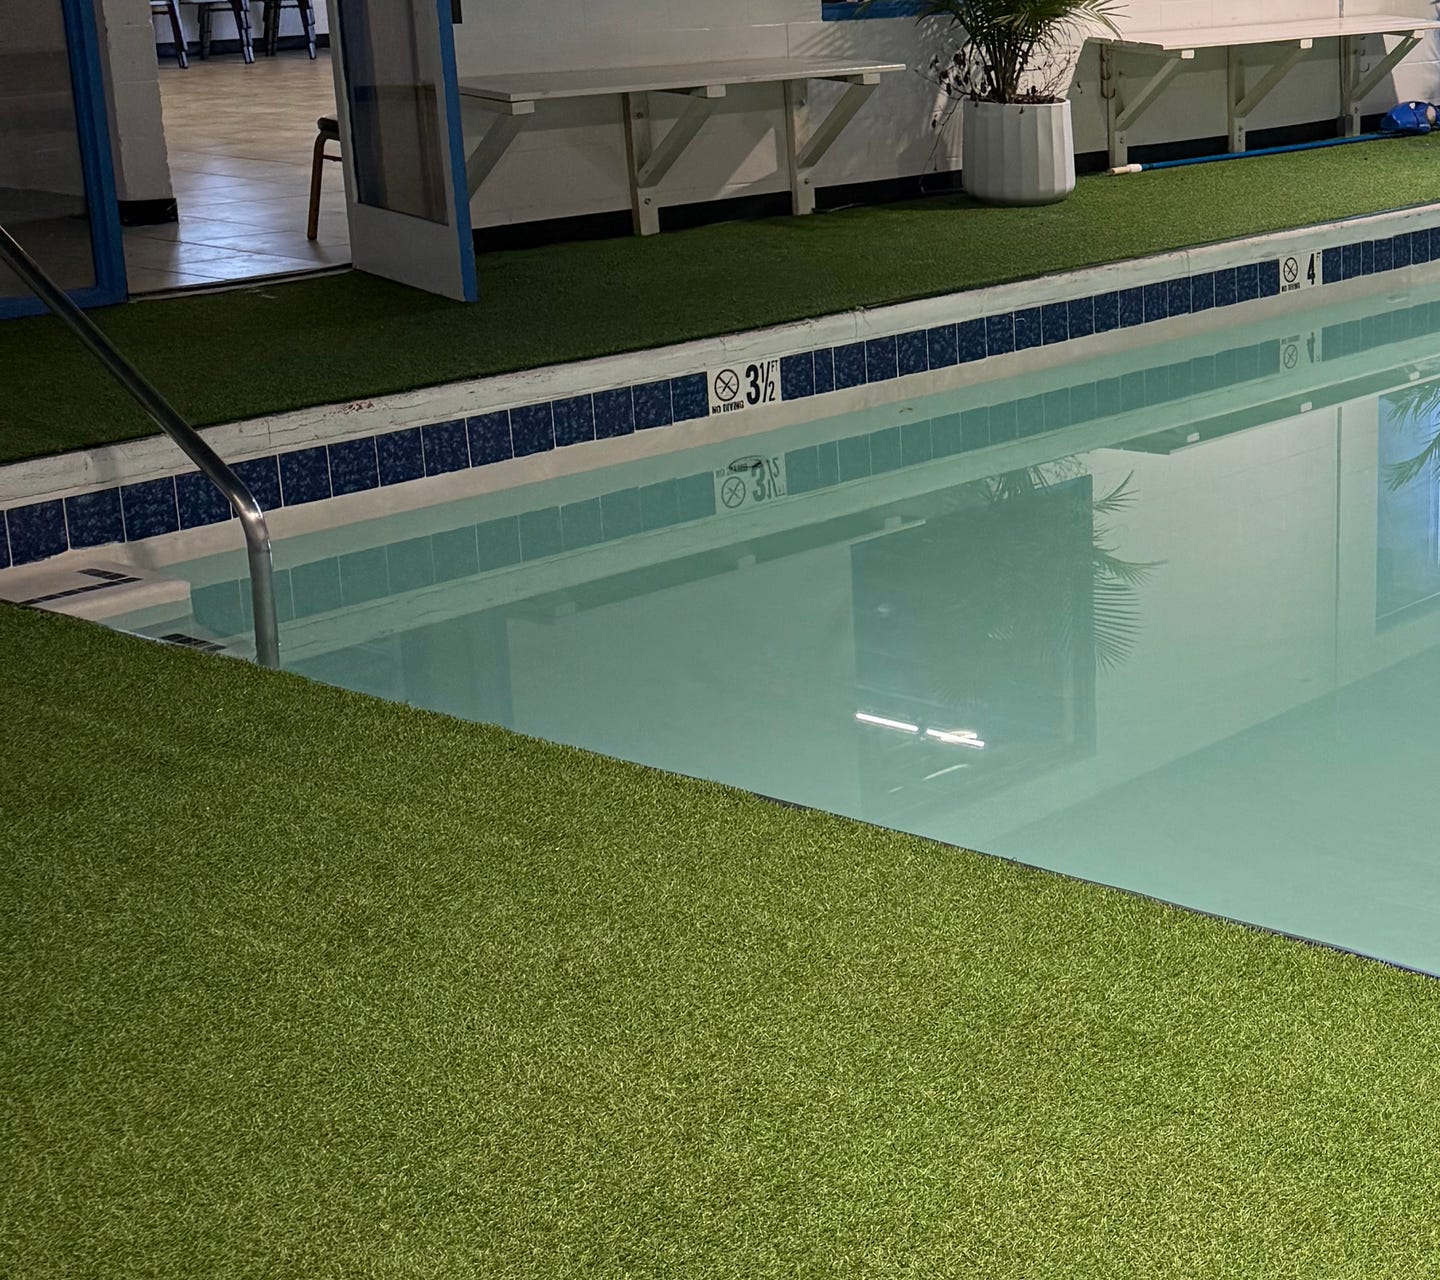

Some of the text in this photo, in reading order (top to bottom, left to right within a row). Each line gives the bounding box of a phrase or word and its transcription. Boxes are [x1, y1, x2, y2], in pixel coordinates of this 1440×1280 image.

[1306, 253, 1316, 286] 4
[711, 400, 745, 415] NO DIVING
